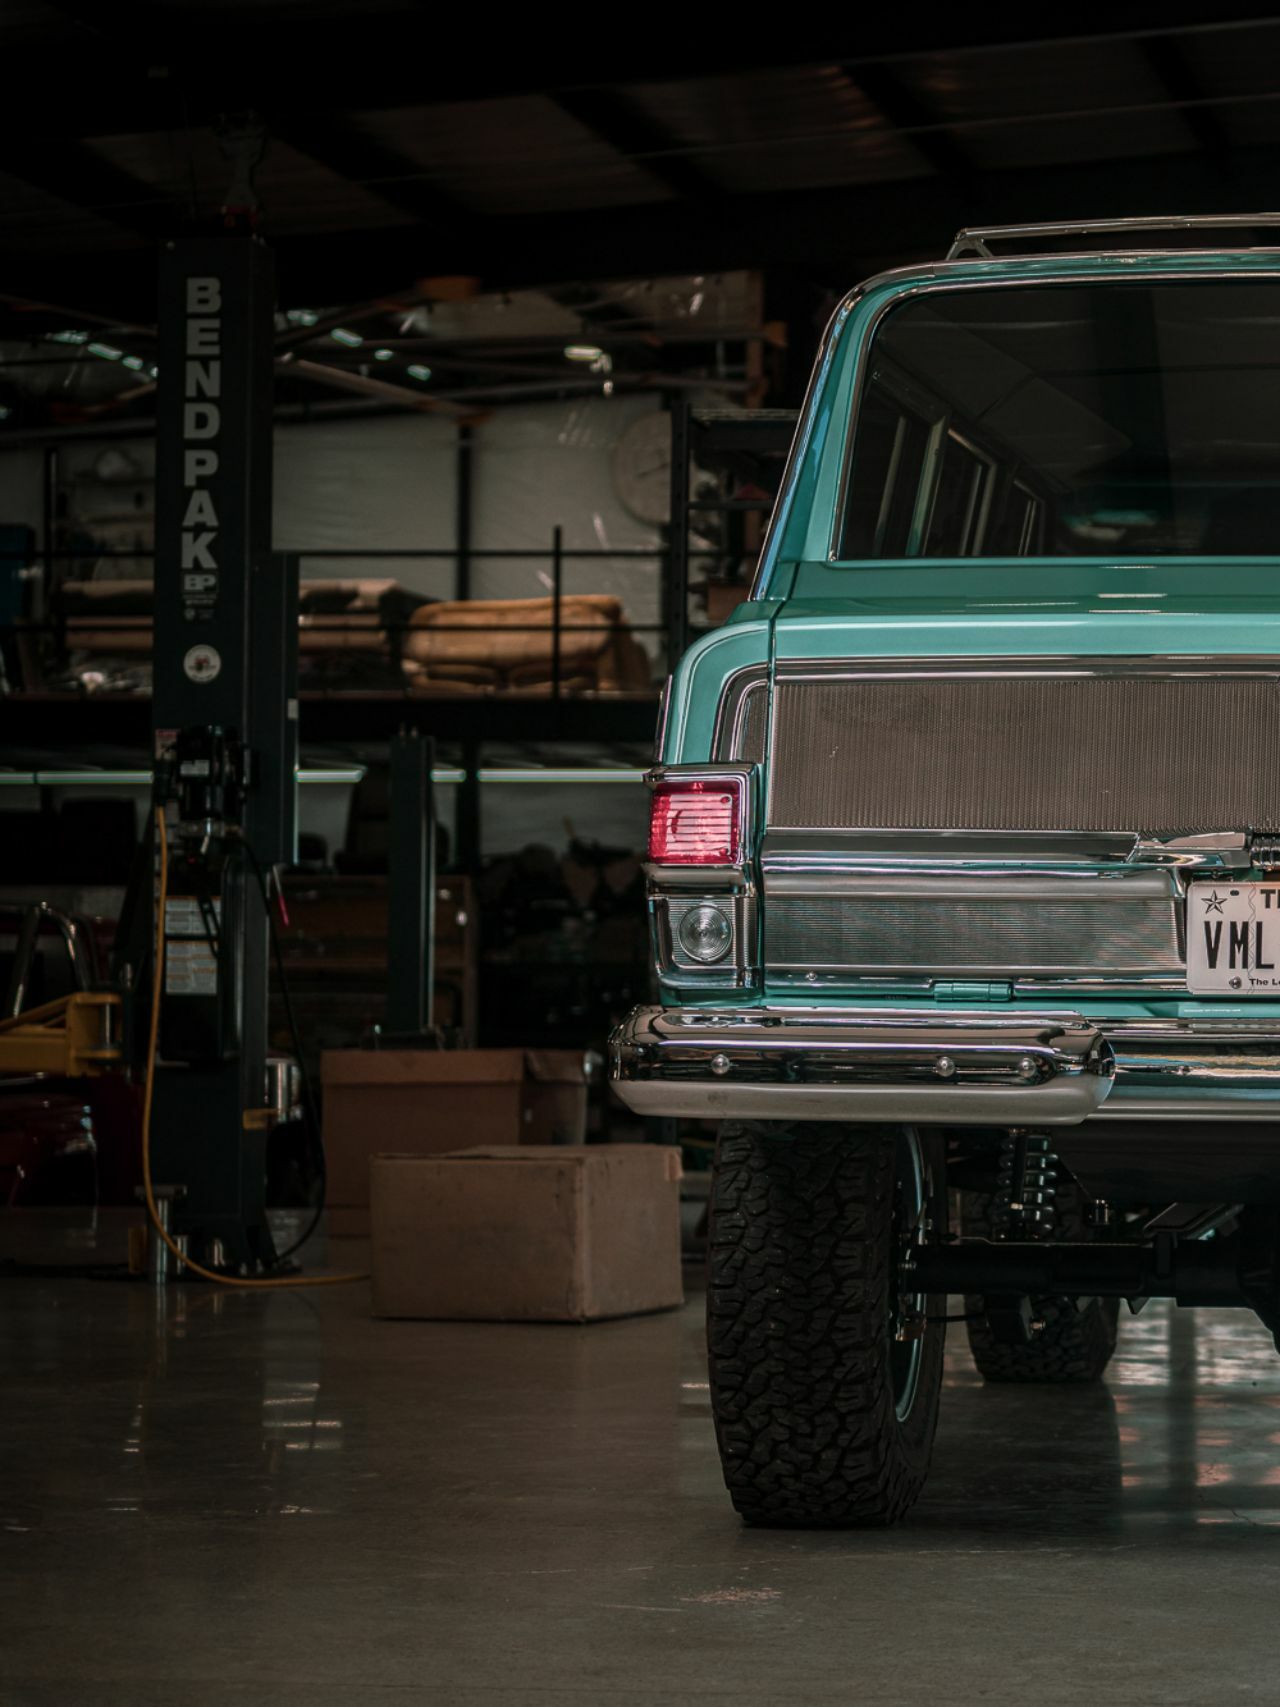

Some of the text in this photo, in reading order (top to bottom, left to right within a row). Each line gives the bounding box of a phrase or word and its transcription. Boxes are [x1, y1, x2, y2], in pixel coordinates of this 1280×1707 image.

[181, 277, 222, 569] BENDPAK
[183, 573, 218, 591] BP
[1204, 920, 1275, 969] VML
[1249, 978, 1269, 986] The
